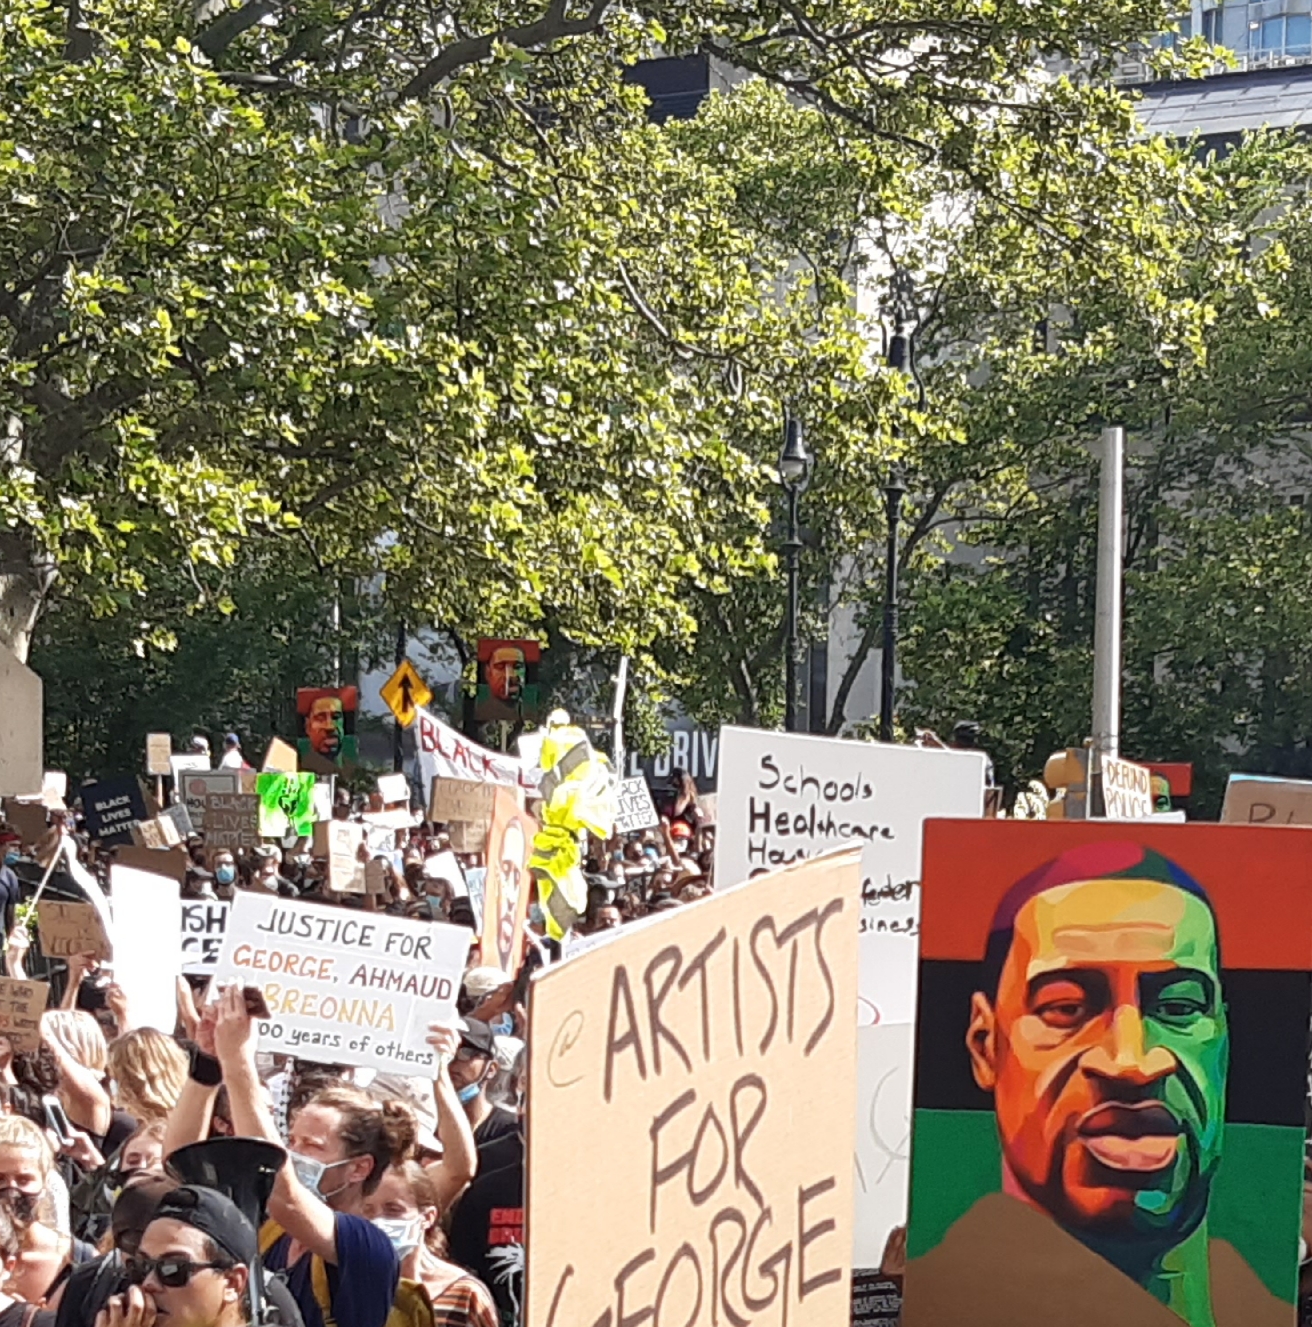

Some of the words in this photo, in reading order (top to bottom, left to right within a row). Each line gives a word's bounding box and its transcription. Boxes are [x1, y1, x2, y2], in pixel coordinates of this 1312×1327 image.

[420, 716, 499, 780] BLACK
[759, 754, 873, 802] Schools
[1107, 760, 1147, 795] DEFUND
[94, 795, 131, 812] BLACK
[101, 808, 132, 824] LIVES
[211, 795, 259, 810] BLACK
[213, 815, 258, 830] LIVES
[749, 796, 895, 842] Healthcare
[257, 908, 375, 947] JUSTICE
[385, 932, 432, 960] FOR
[233, 944, 339, 984] GEORGE,
[348, 964, 453, 1000] AHMAUD
[264, 983, 396, 1032] BREONNA
[603, 896, 845, 1104] ARTISTS
[258, 1022, 283, 1039] 00
[285, 1029, 341, 1047] years
[349, 1036, 370, 1053] of
[376, 1043, 433, 1066] others
[648, 1072, 769, 1235] FOR
